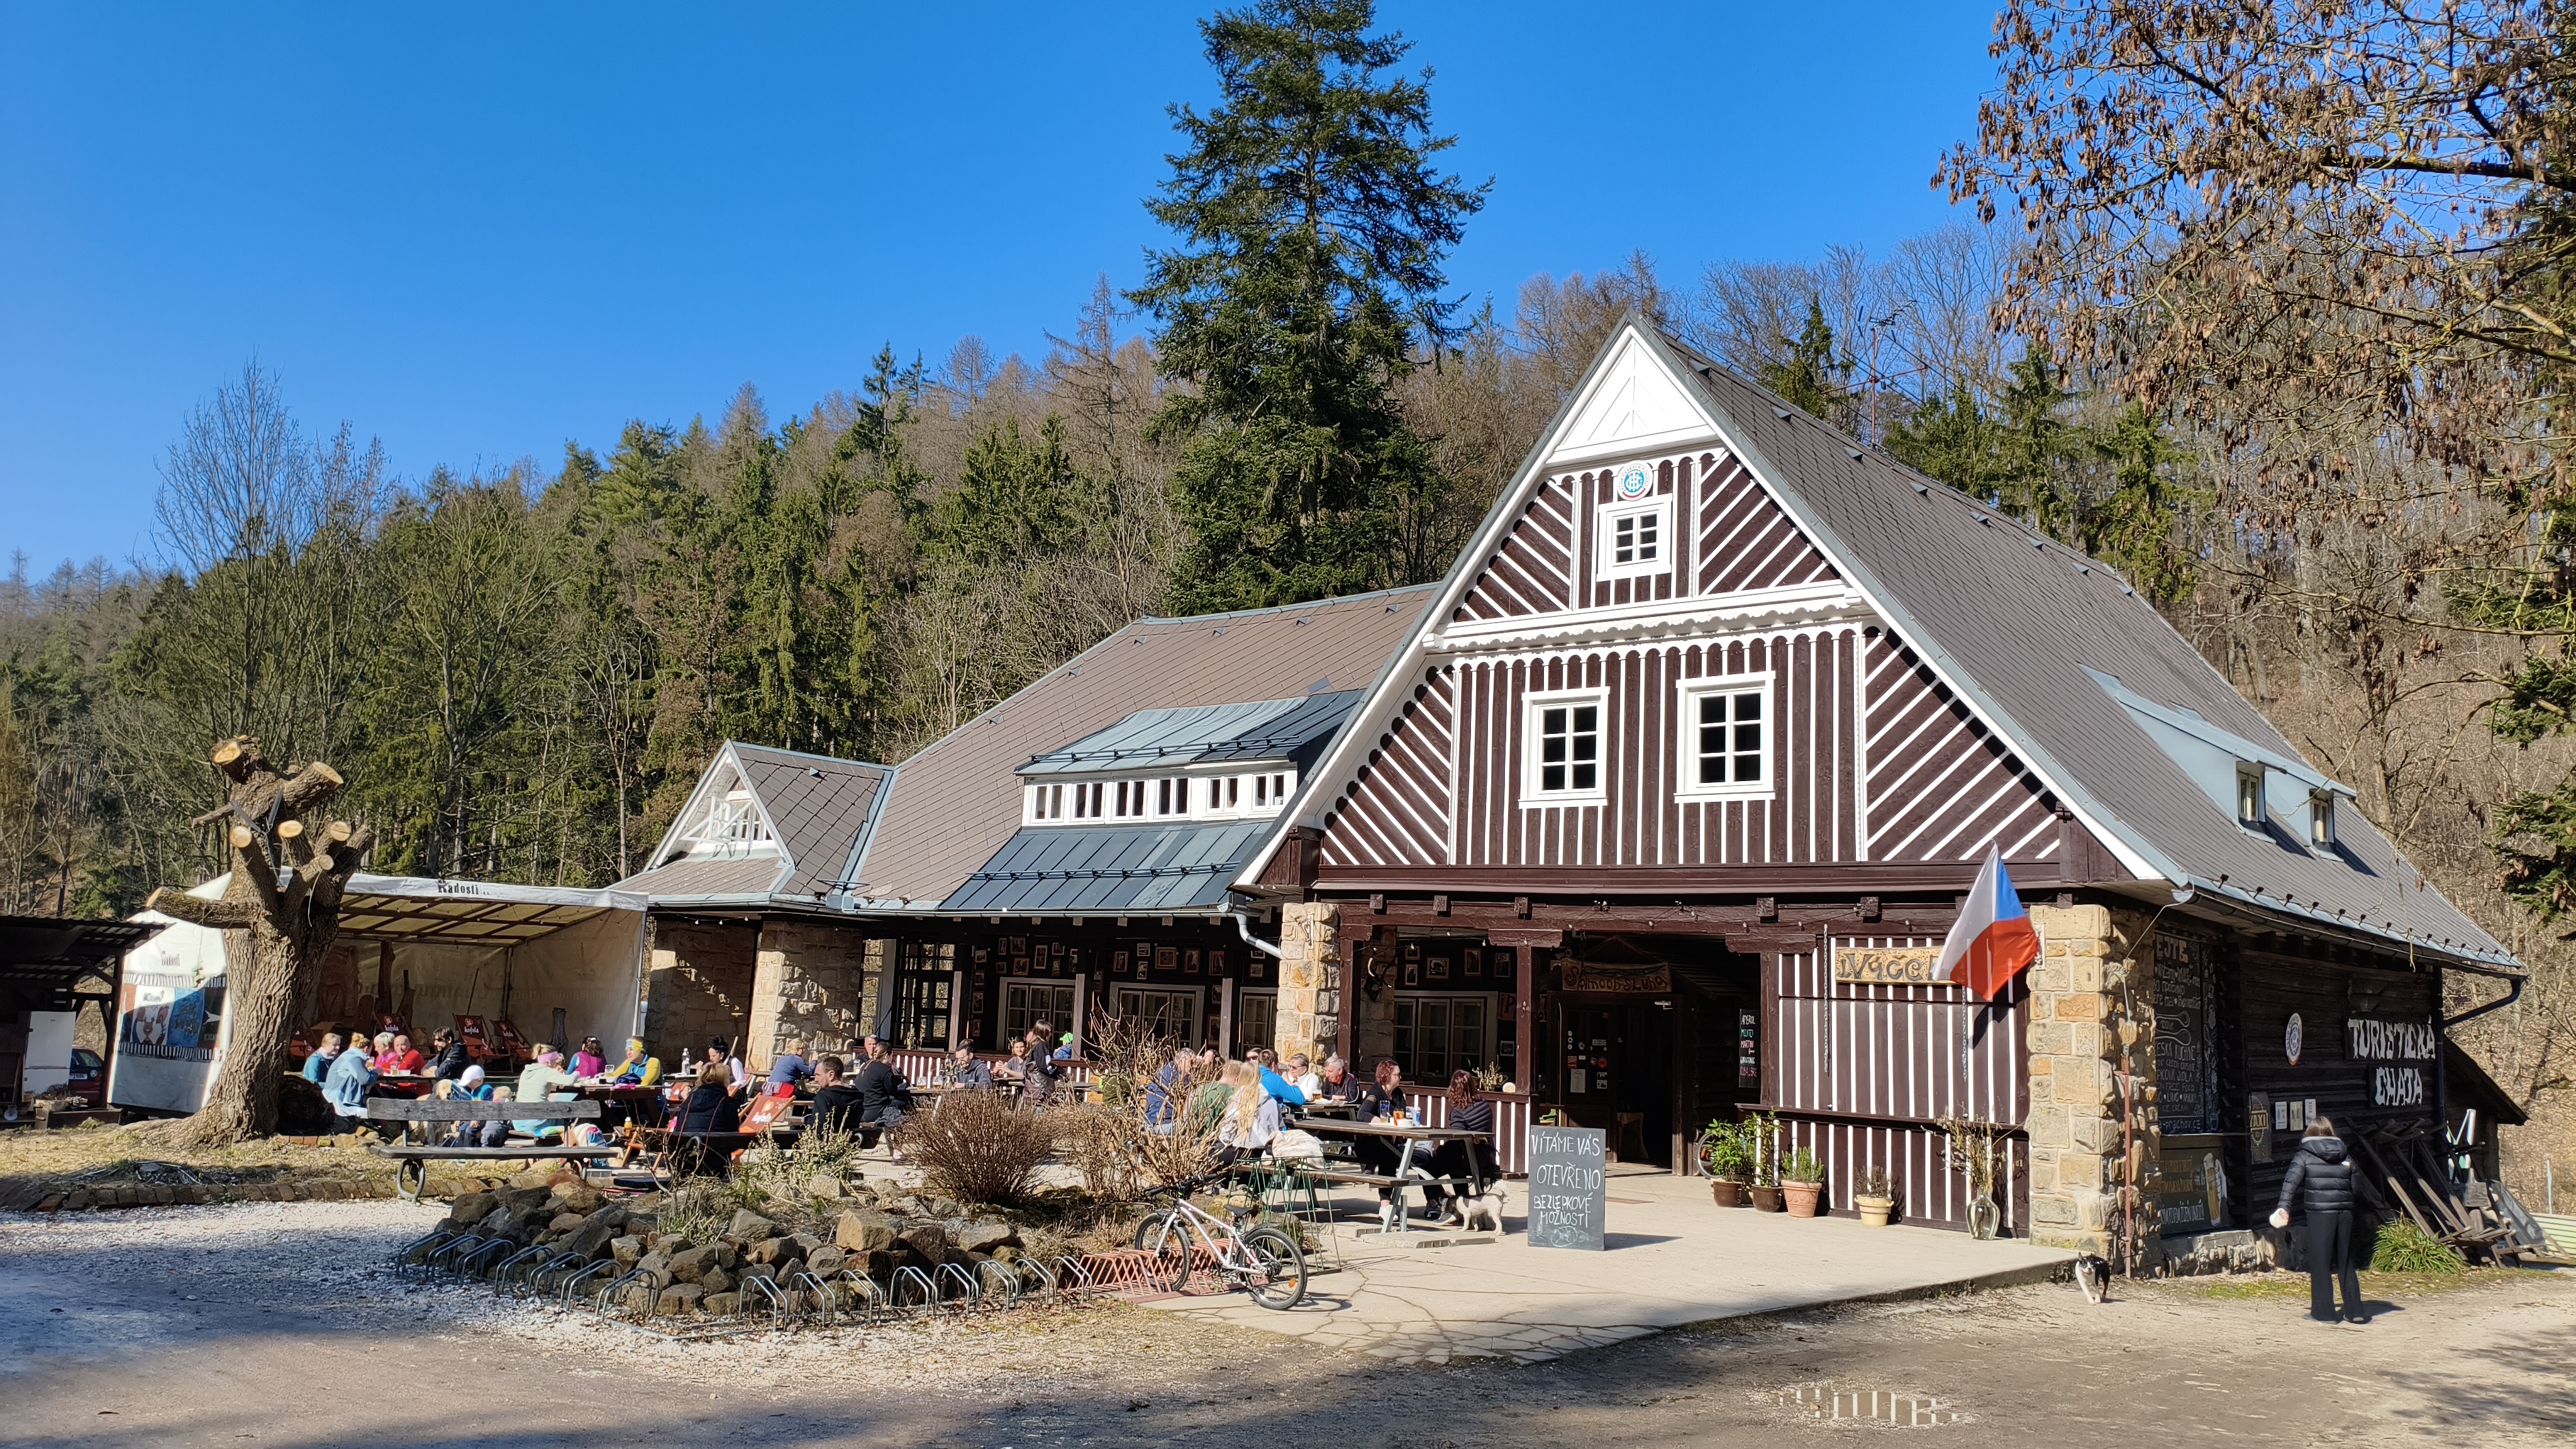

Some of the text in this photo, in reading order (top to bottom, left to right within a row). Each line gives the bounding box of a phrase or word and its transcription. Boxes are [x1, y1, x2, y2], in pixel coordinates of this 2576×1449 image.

[2156, 934, 2188, 963] EJTE
[1741, 1014, 1755, 1024] APEROL
[2375, 1067, 2423, 1106] CHATA
[1531, 1131, 1601, 1156] VÍTÁME VÁS
[1536, 1162, 1601, 1191] OTEVŘENO
[1533, 1192, 1594, 1213] BEZLEPKOVÉ
